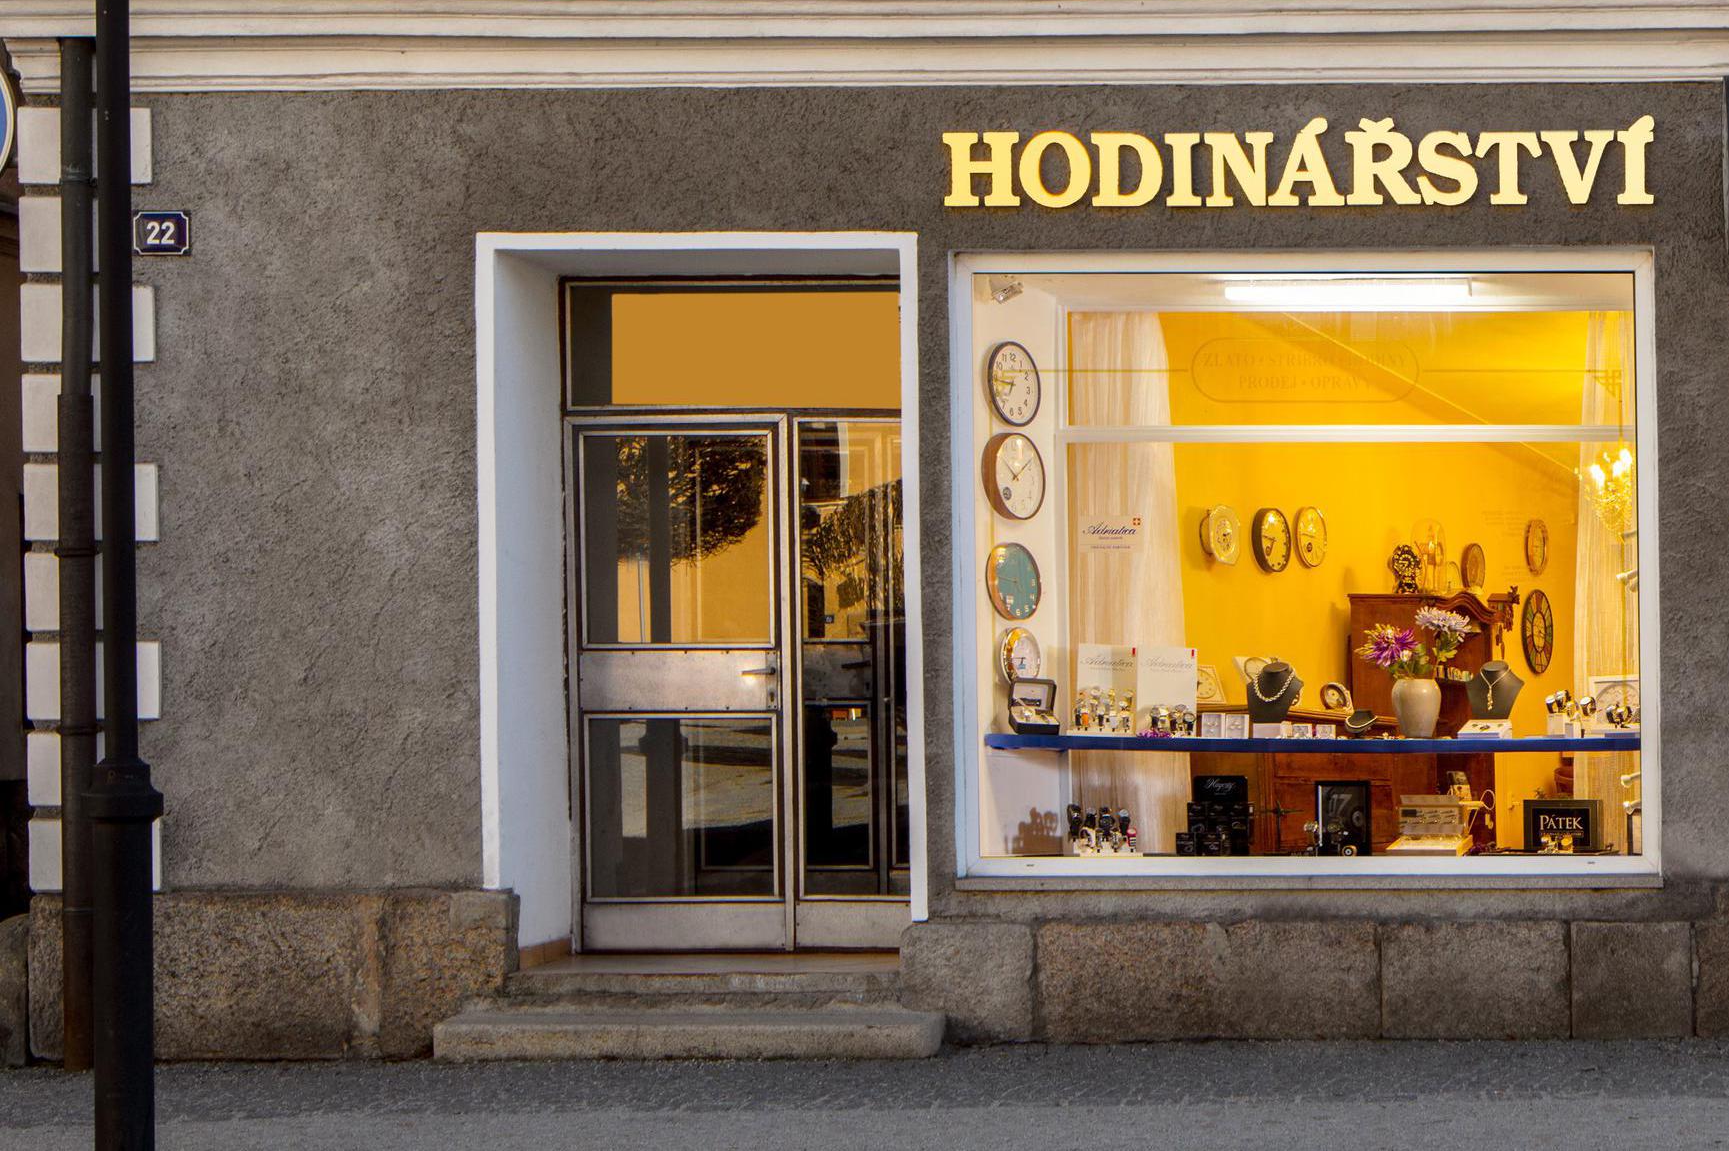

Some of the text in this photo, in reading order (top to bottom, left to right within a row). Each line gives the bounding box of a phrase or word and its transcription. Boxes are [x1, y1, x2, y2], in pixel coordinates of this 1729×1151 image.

[942, 115, 1655, 208] HODINÁŘSTVÍ
[146, 221, 175, 245] 22
[1539, 813, 1584, 830] PÁTEK
